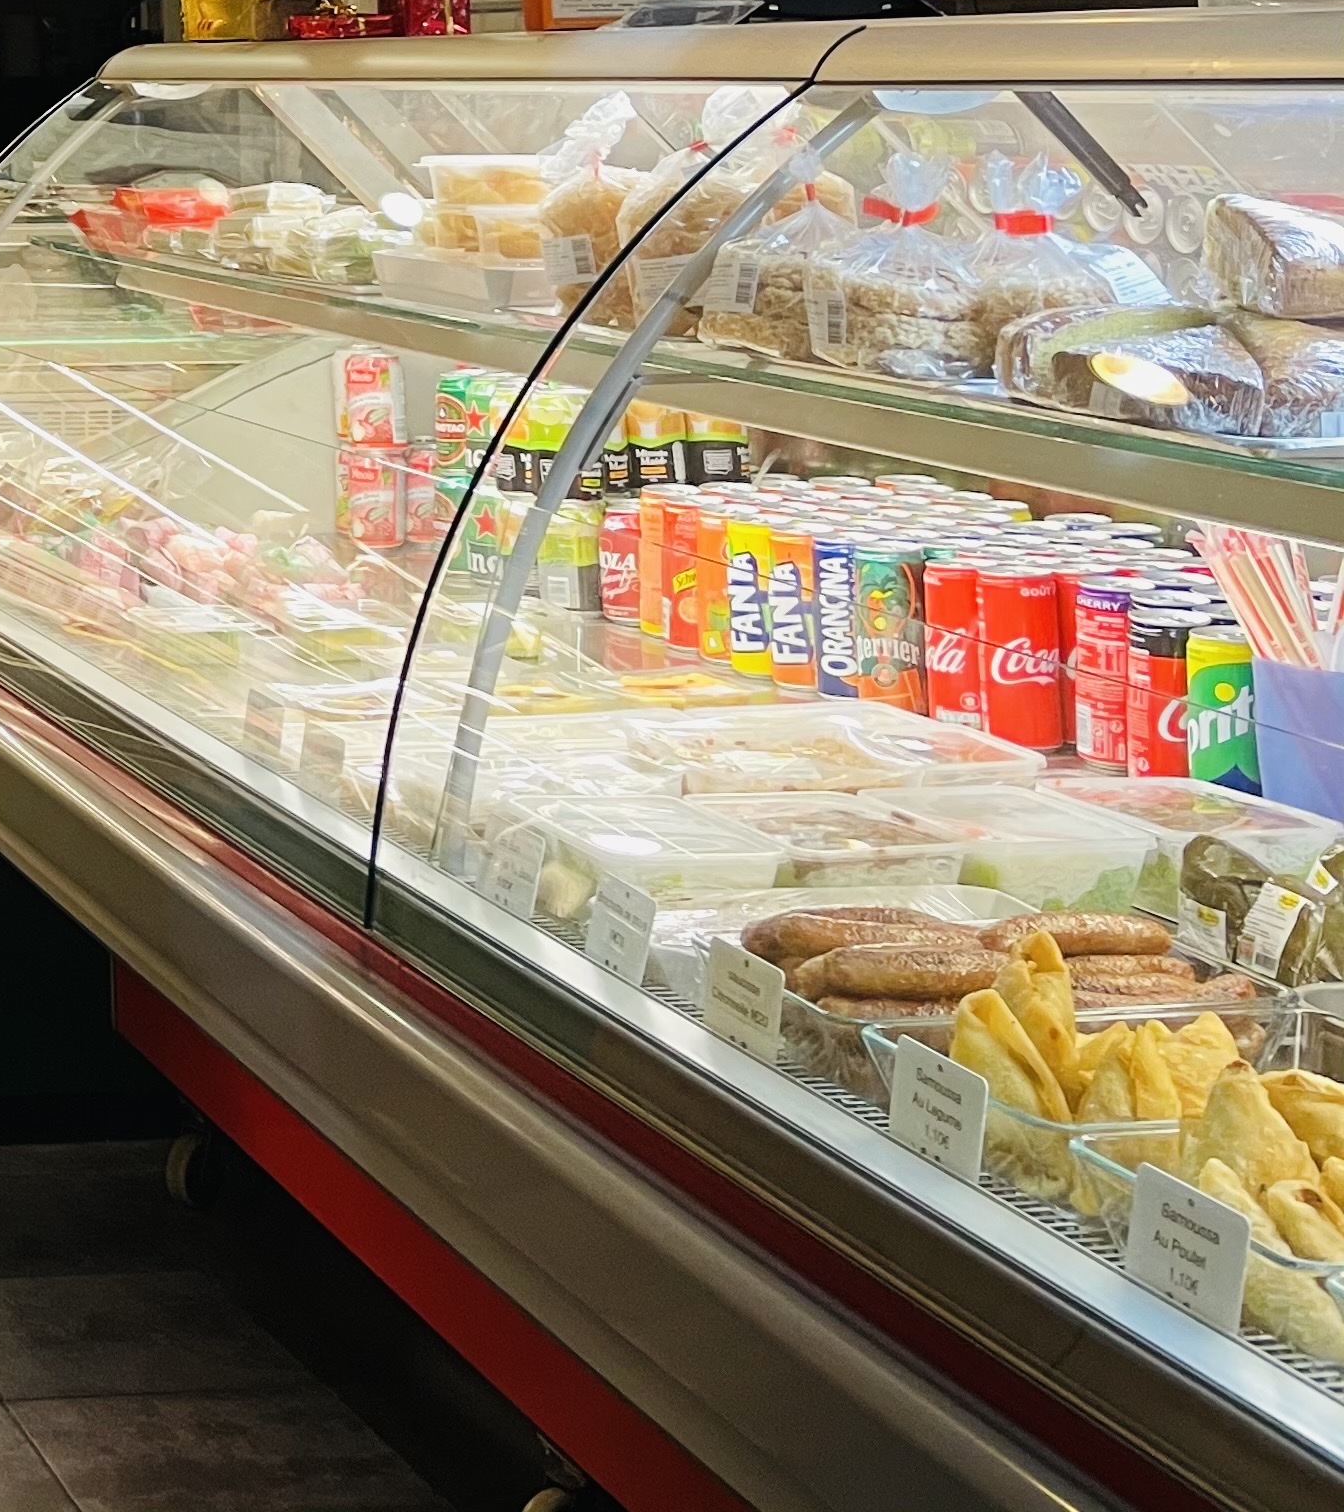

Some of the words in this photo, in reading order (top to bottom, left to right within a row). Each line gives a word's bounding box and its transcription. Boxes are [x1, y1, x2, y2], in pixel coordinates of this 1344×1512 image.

[727, 552, 767, 652] FANTA
[768, 562, 809, 664] FANTA
[1153, 1229, 1168, 1249] Au
[1172, 1238, 1206, 1269] Poulet
[1161, 1202, 1220, 1245] Samoussa
